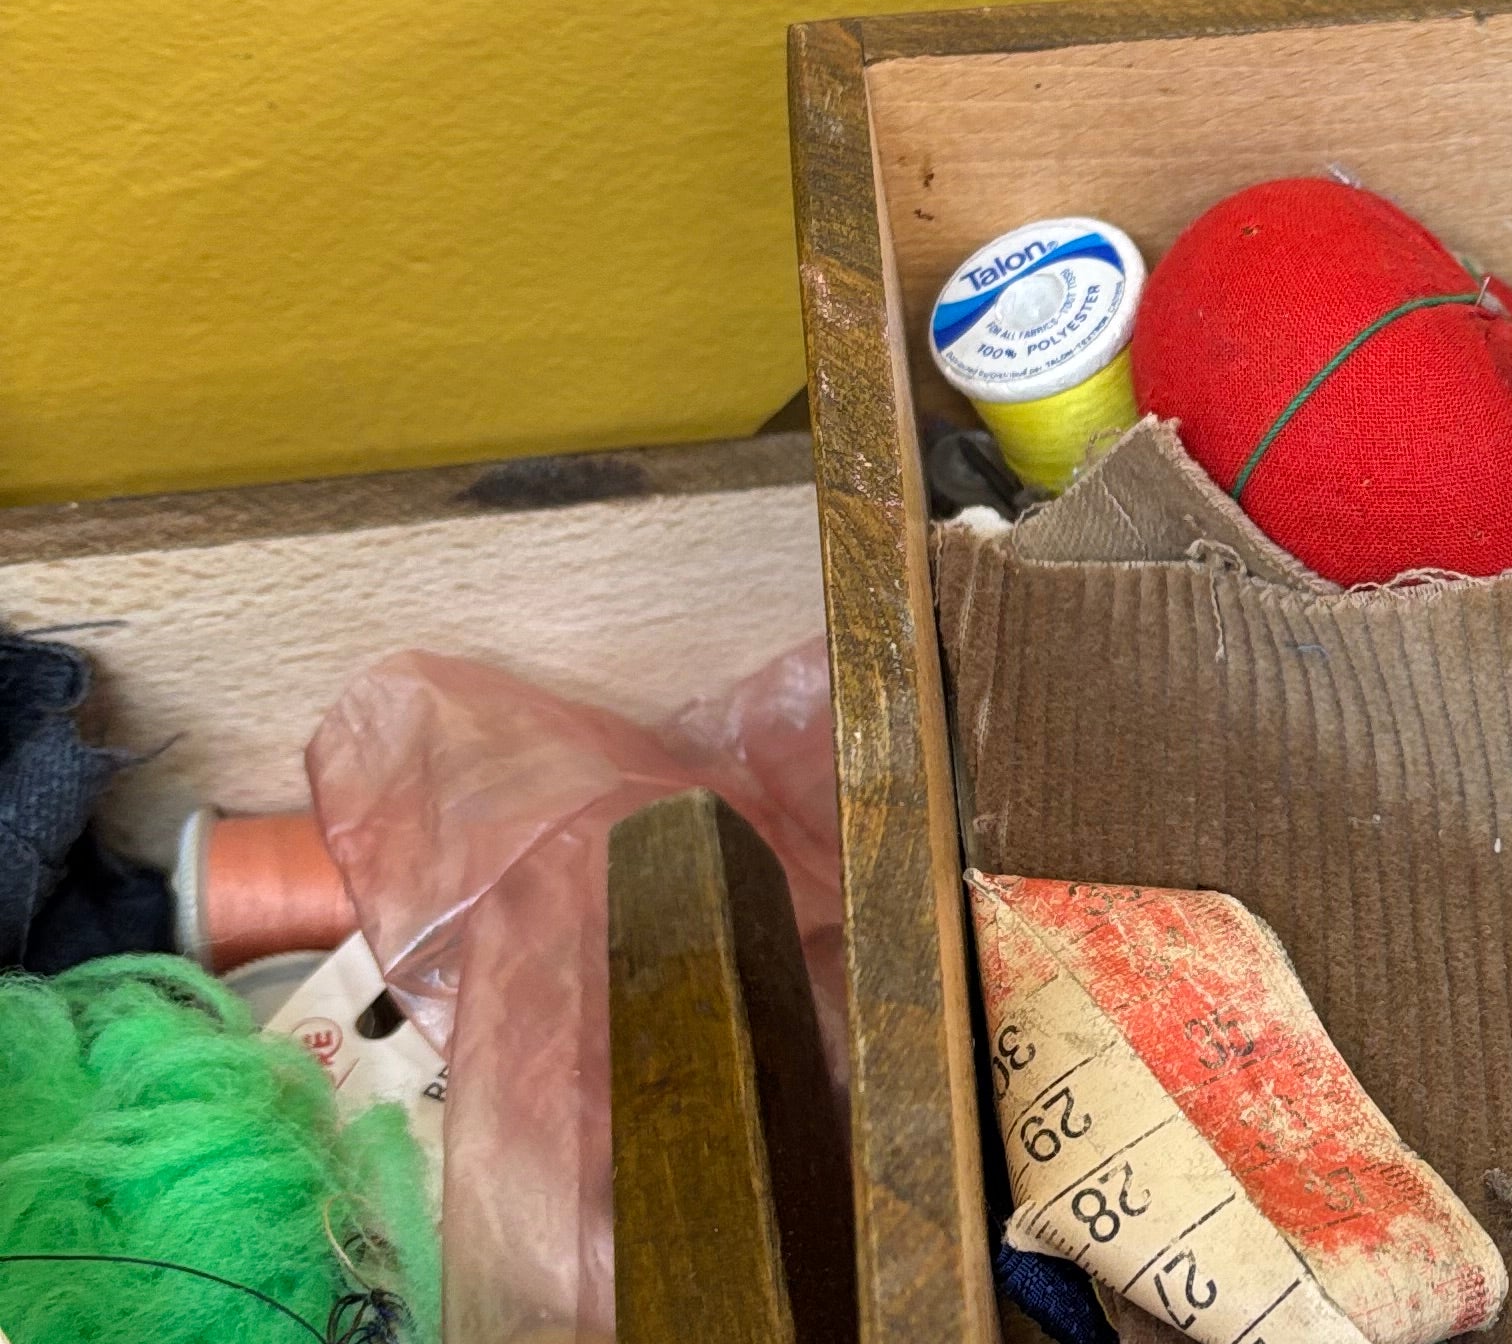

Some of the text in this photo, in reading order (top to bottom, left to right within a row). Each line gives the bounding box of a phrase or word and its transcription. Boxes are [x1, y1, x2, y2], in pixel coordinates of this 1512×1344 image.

[959, 241, 1047, 292] Talon
[977, 284, 1101, 360] 100% POLYESTER
[1020, 1086, 1093, 1163] 29
[1071, 1161, 1153, 1244] 28
[1153, 1248, 1218, 1331] 27
